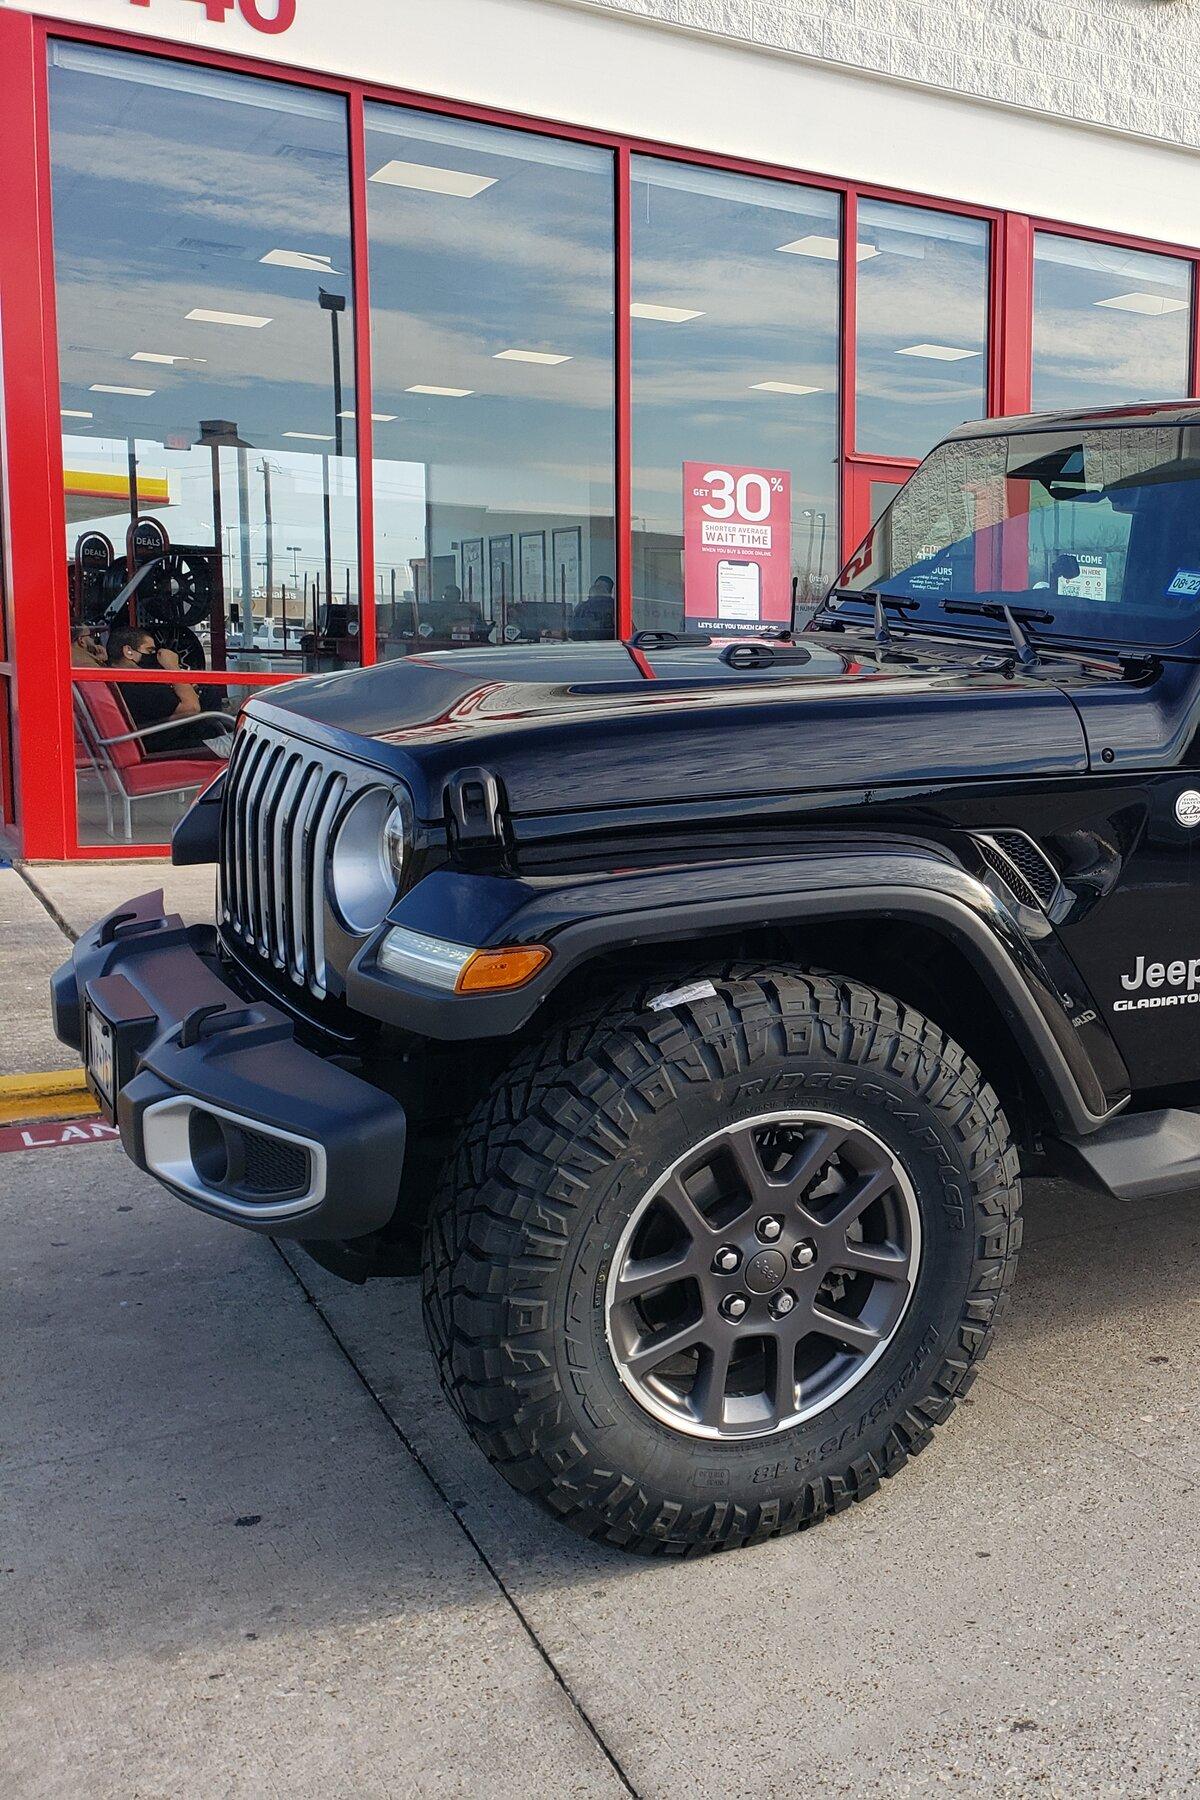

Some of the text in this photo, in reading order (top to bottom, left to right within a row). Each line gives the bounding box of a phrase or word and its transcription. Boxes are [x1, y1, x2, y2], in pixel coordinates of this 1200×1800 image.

[693, 489, 709, 497] GET
[136, 537, 160, 547] DEALS
[705, 532, 768, 545] WAIT TIME
[84, 548, 106, 557] DEALS
[1064, 553, 1102, 565] LCOME
[931, 567, 952, 575] OURS
[1187, 580, 1200, 590] 22
[21, 1123, 119, 1146] LAN
